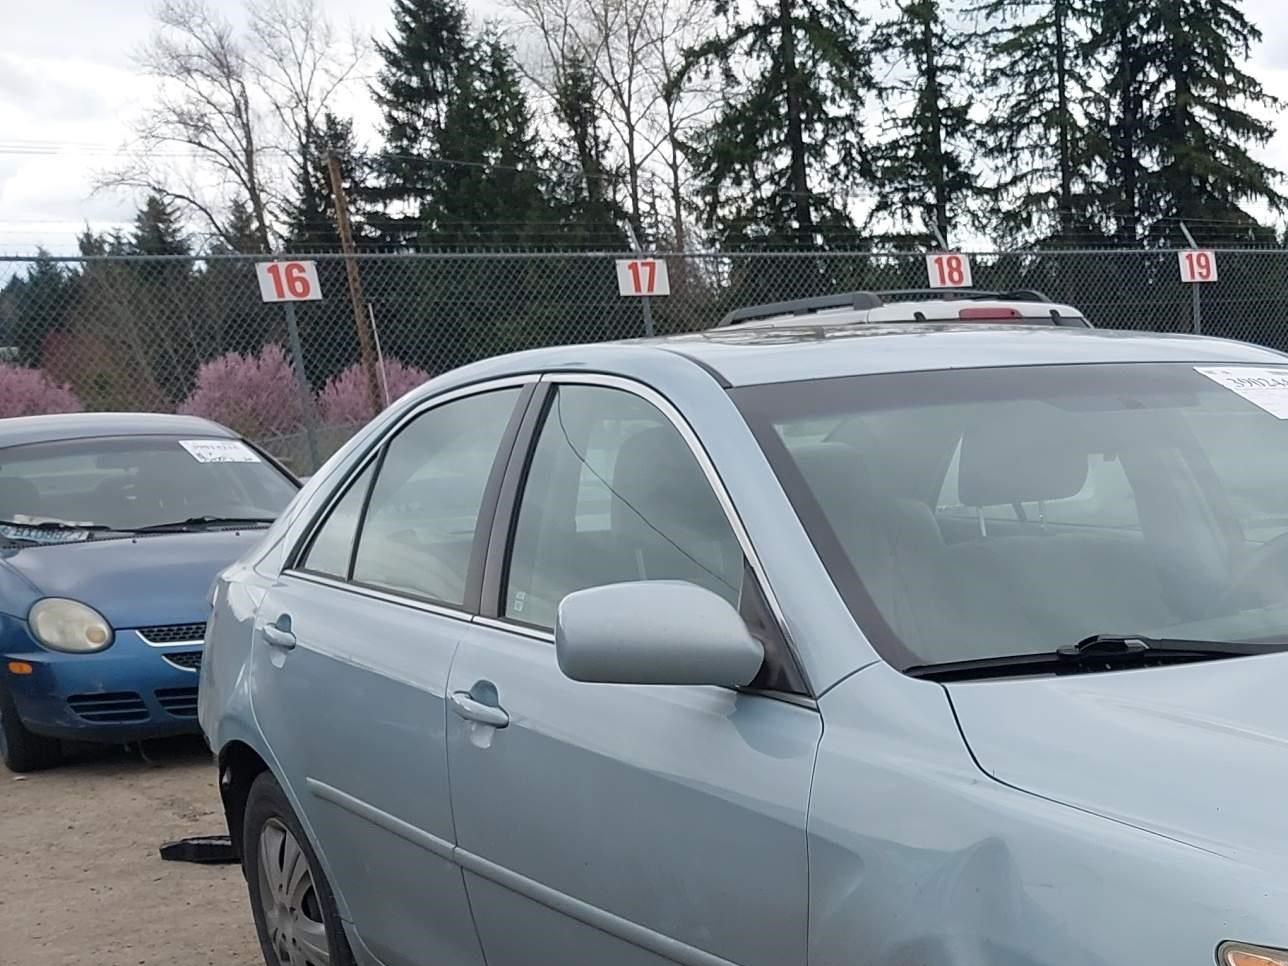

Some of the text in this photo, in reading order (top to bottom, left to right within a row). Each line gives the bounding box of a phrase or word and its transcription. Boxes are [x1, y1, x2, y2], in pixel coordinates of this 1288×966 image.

[267, 262, 311, 299] 16
[627, 261, 657, 294] 17
[935, 255, 965, 287] 18
[1185, 253, 1211, 280] 19
